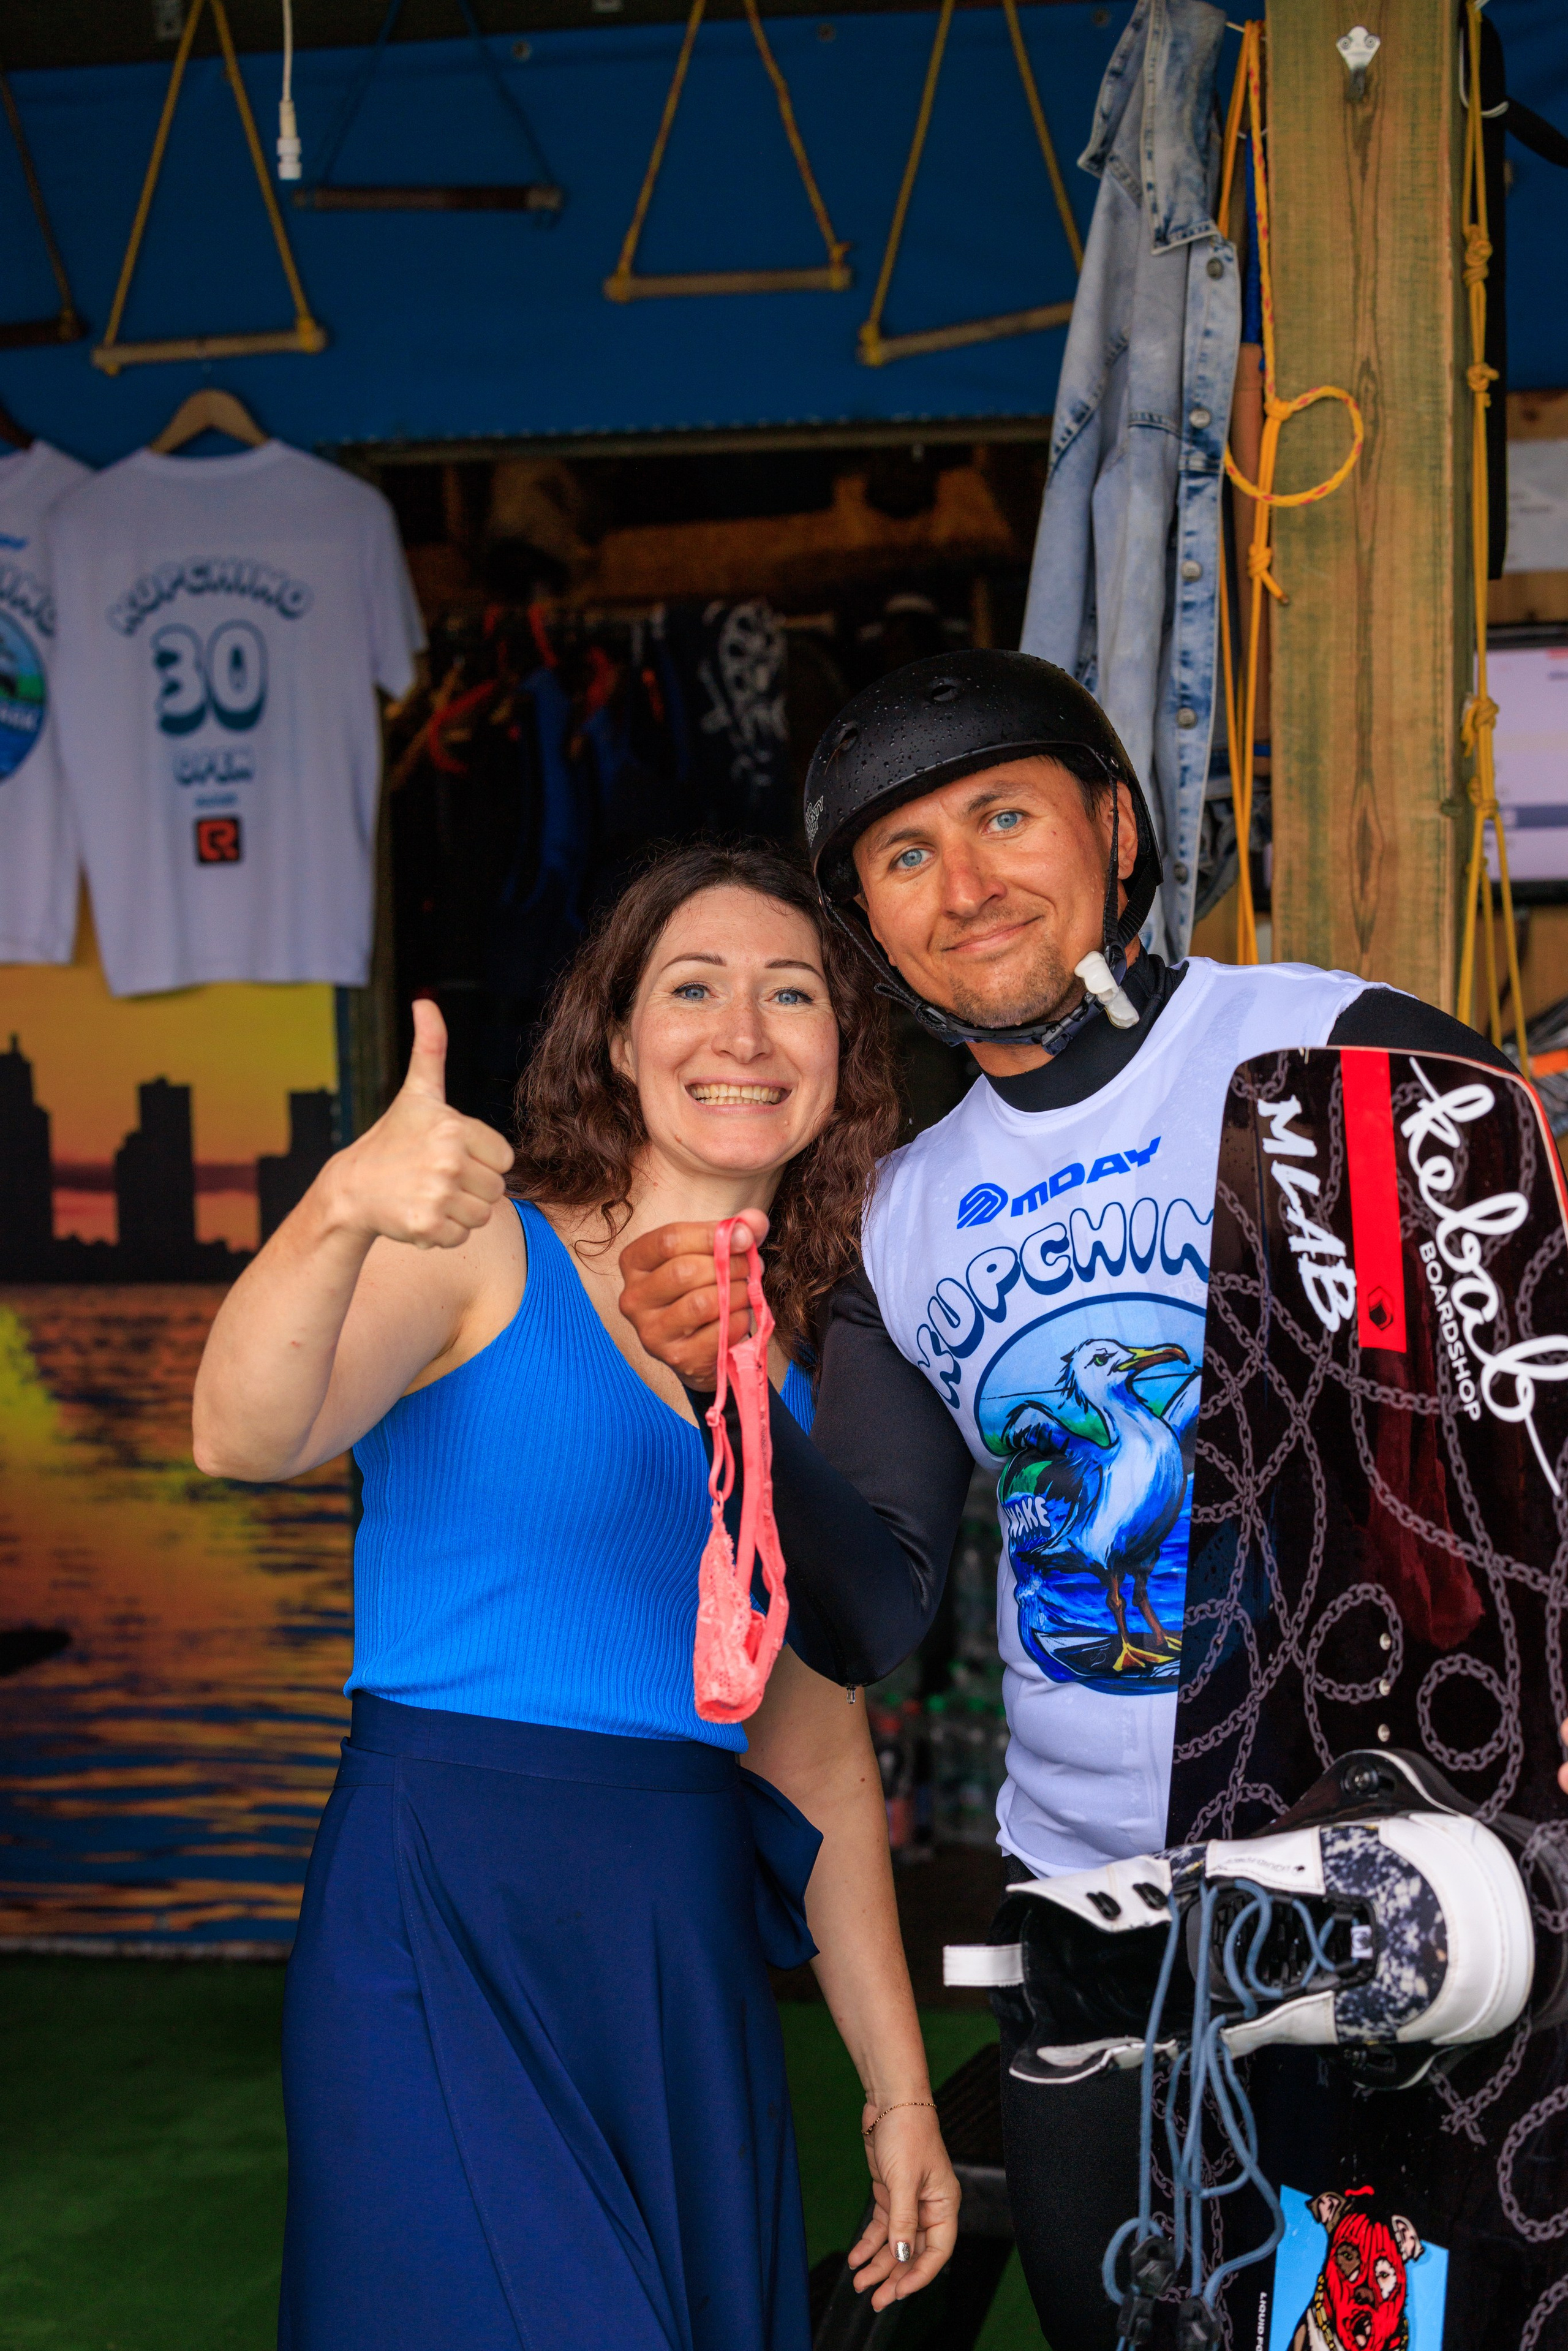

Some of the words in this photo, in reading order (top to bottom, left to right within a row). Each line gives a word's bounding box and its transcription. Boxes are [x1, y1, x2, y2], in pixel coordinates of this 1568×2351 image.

[151, 621, 268, 736] 30
[1257, 1095, 1357, 1333] MLAB
[1419, 1240, 1481, 1422] BOARDSHOP
[1003, 1496, 1051, 1540] WAKE
[1256, 2291, 1268, 2336] LIQUID
